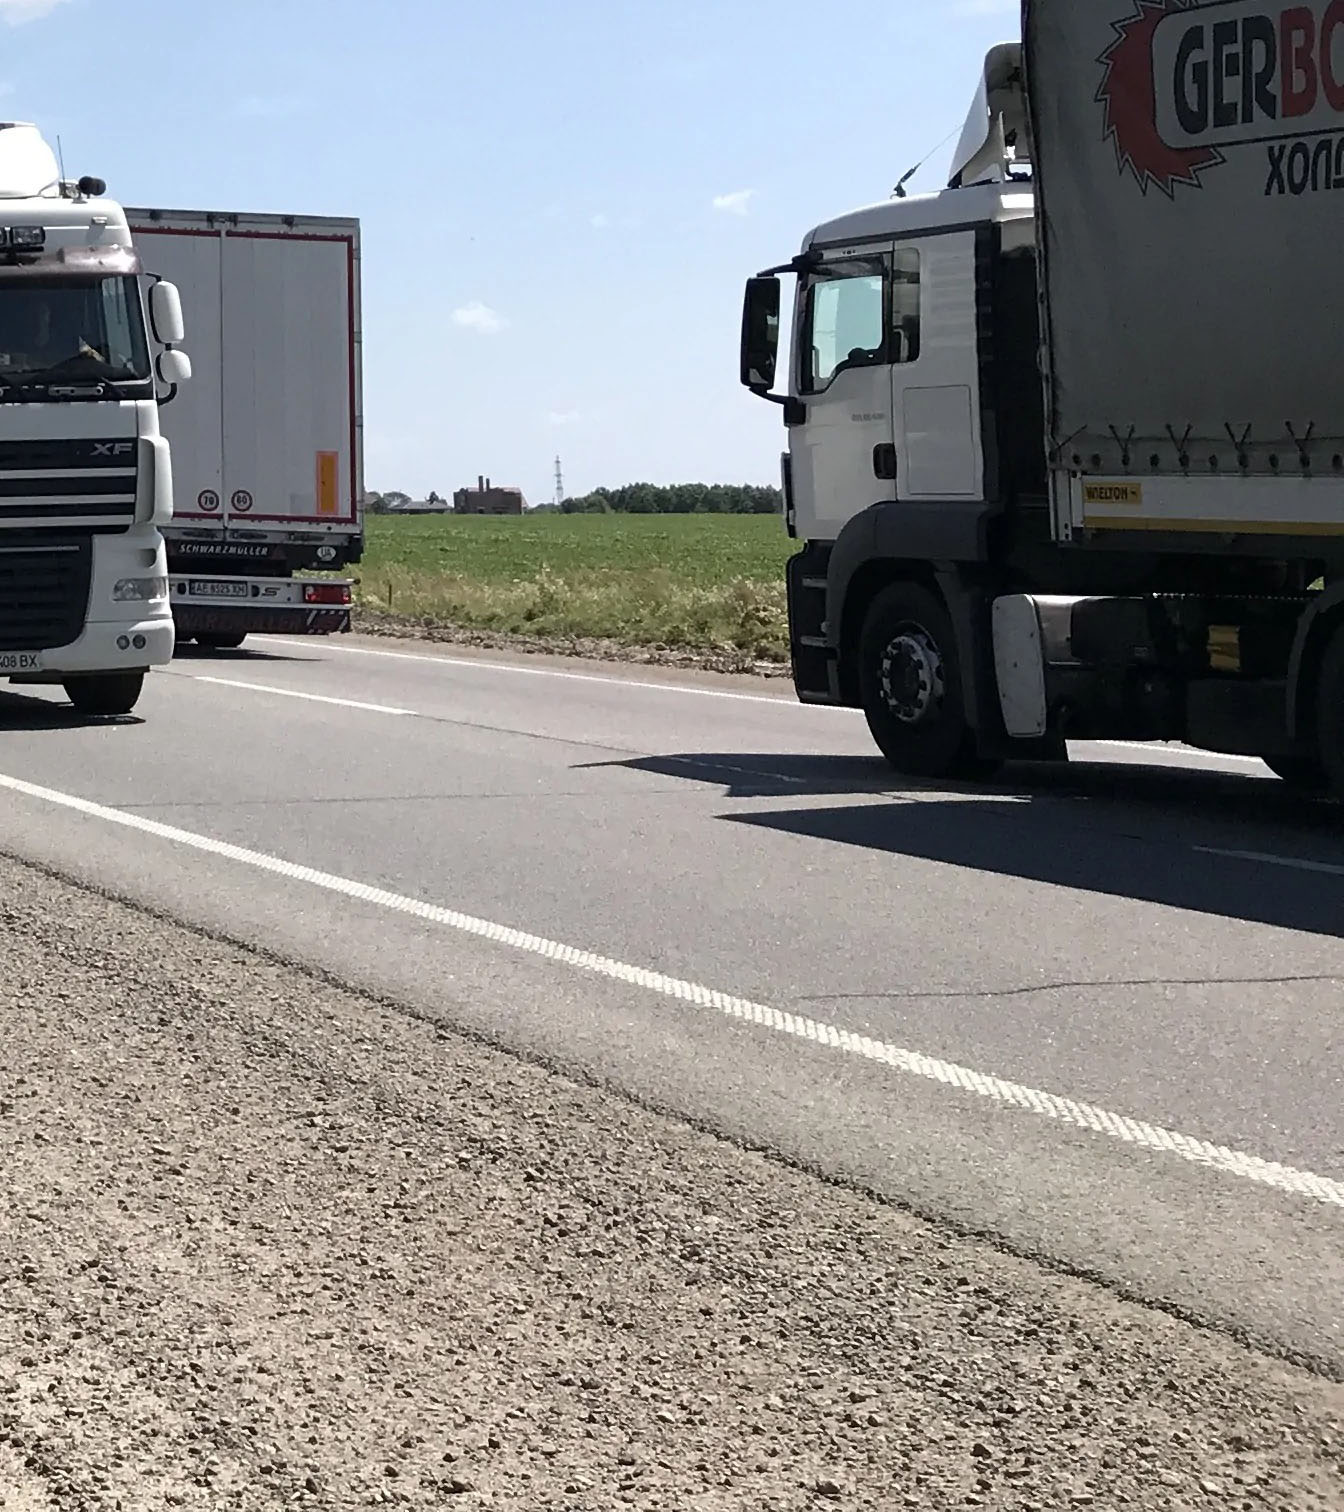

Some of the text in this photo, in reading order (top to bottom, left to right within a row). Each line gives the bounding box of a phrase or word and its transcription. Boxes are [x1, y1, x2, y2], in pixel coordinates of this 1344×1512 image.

[90, 442, 133, 456] XF
[1085, 486, 1128, 500] WIELTON
[19, 654, 37, 668] BX
